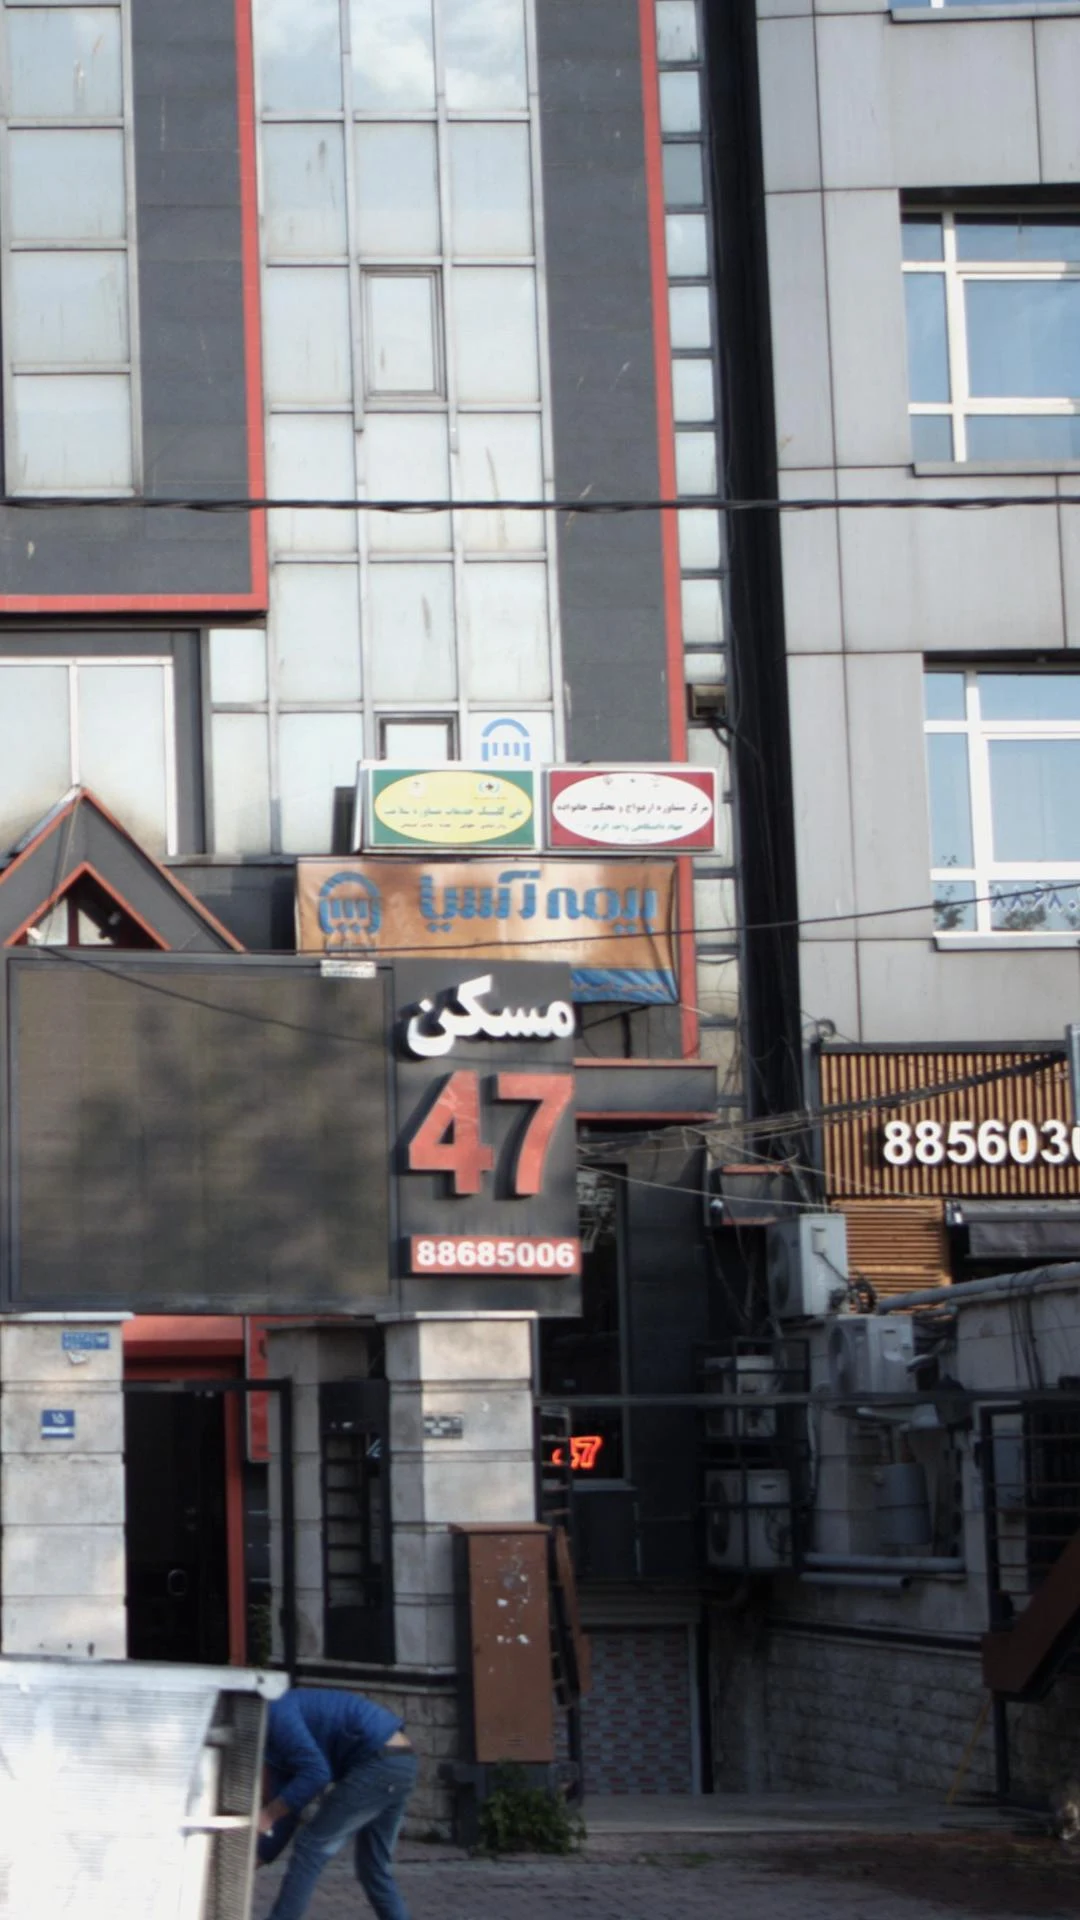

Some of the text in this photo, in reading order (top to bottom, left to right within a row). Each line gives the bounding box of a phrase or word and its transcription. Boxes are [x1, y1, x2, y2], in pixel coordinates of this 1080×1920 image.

[556, 803, 588, 814] خانواده
[591, 801, 616, 813] تحکیم
[624, 802, 654, 815] ازدواج
[656, 802, 686, 815] مشاوره
[688, 802, 709, 815] مرکز
[419, 869, 658, 934] بیمه آسیا
[406, 973, 576, 1057] مسکن
[408, 1069, 576, 1195] 47
[416, 1239, 576, 1268] 88685006
